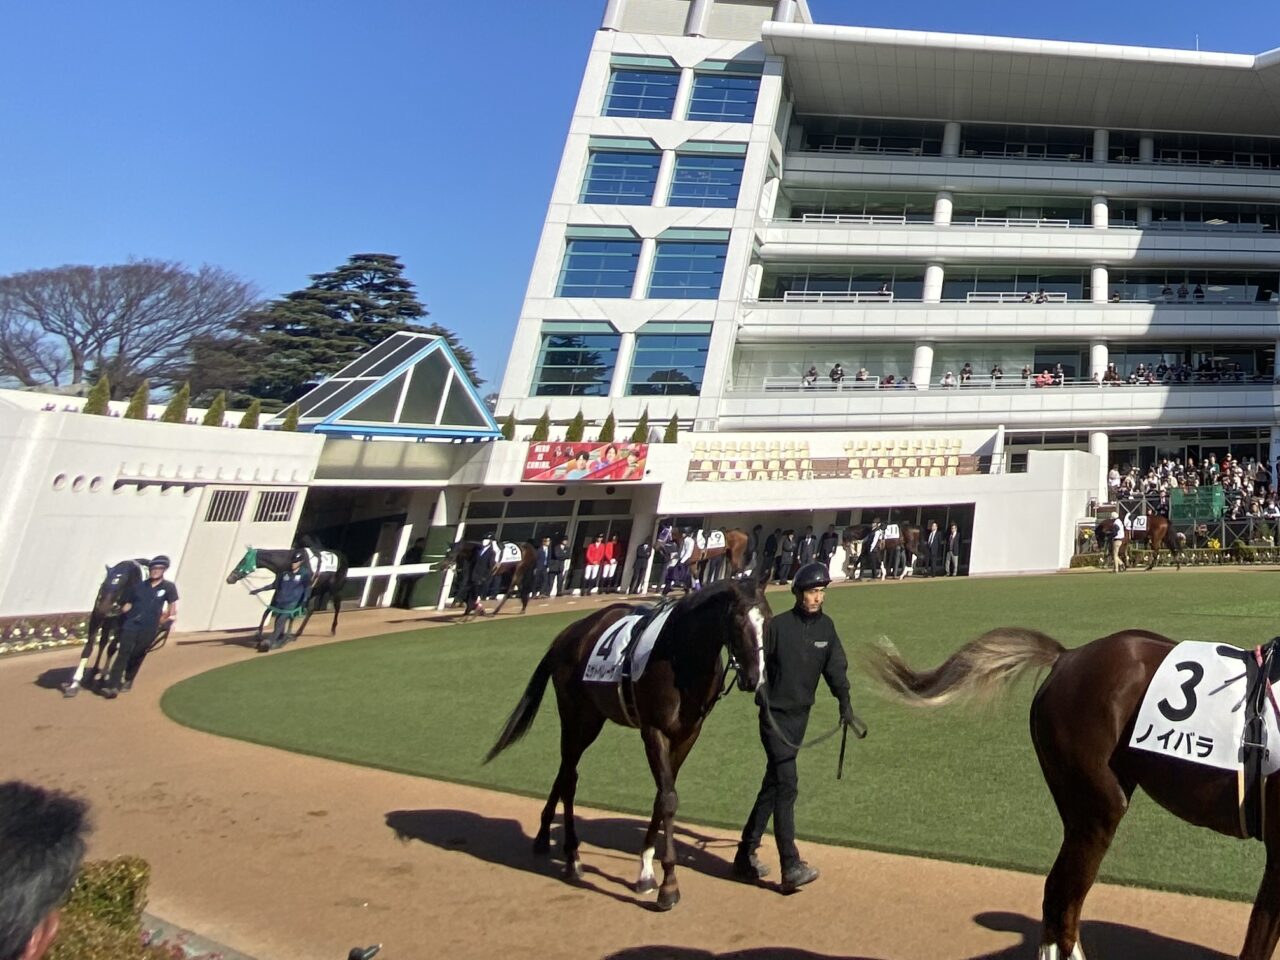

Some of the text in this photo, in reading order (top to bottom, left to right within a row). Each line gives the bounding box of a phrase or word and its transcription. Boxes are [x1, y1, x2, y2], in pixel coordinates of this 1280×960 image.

[596, 621, 629, 661] 4
[1157, 660, 1205, 722] 3
[1135, 723, 1214, 758] ノイバラ
